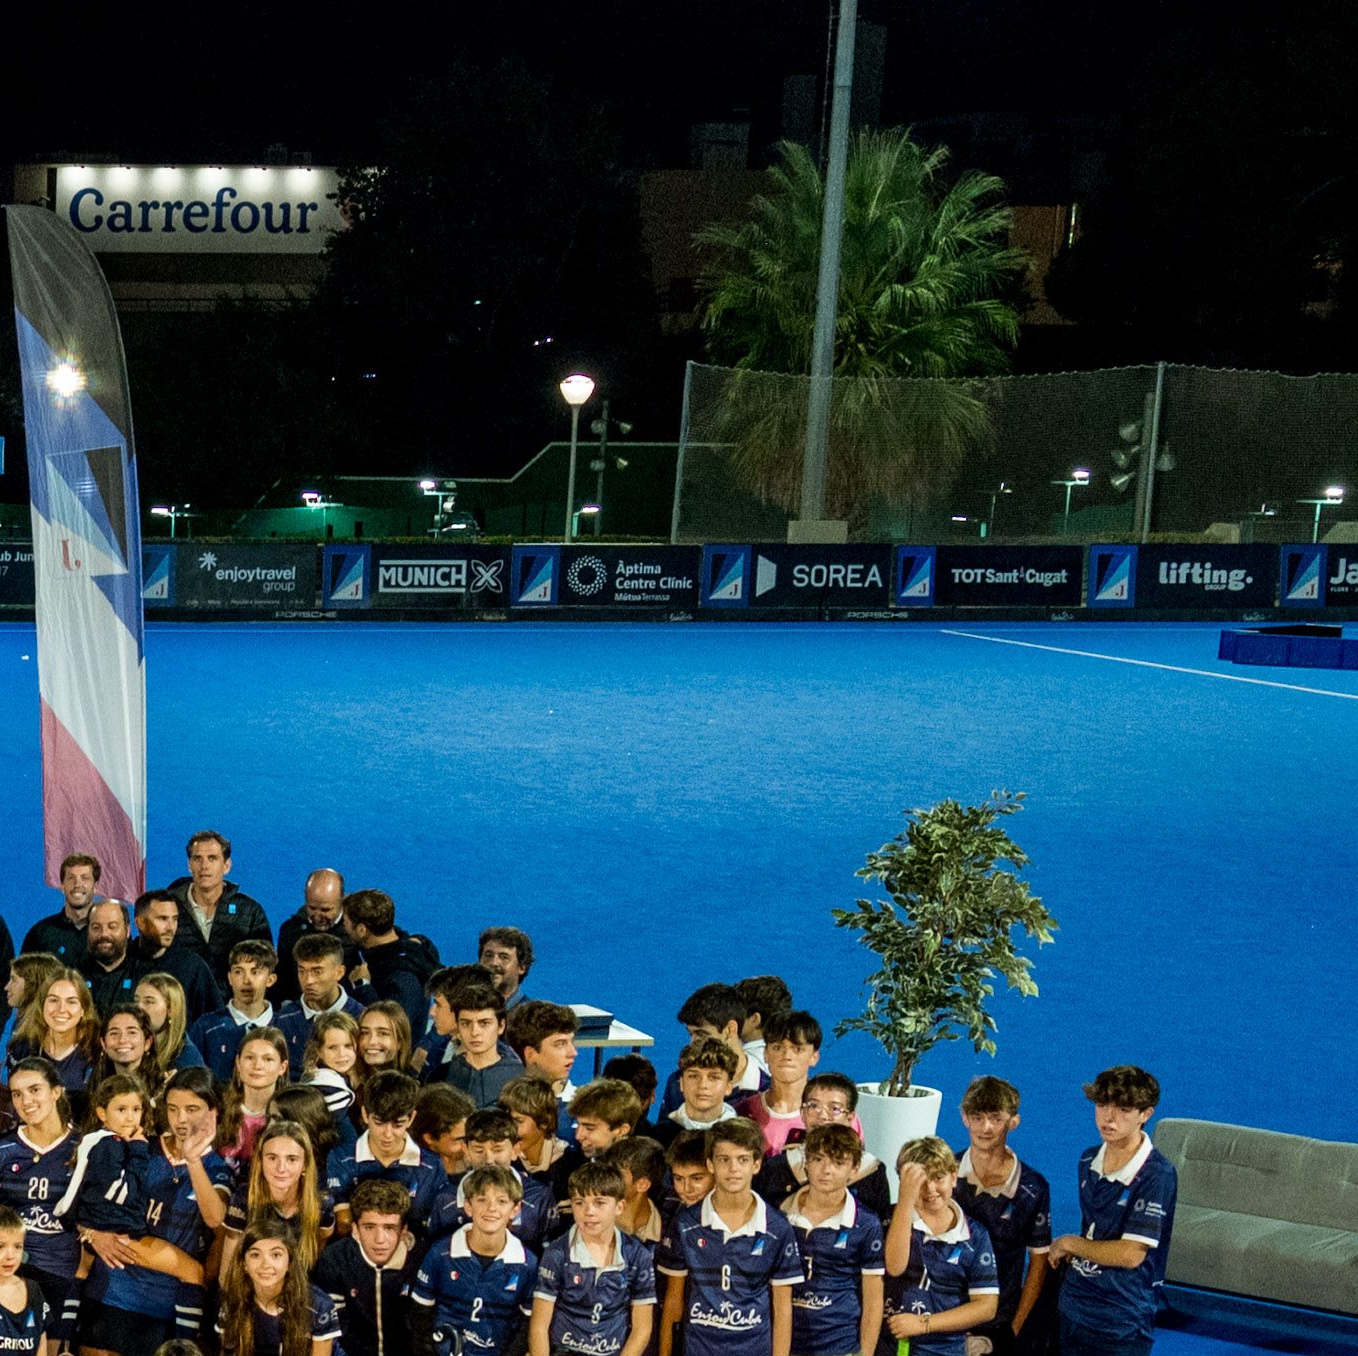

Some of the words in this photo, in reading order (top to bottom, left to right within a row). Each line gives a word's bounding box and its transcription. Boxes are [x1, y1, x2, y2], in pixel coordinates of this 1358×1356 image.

[69, 187, 318, 234] Carrefour
[14, 550, 35, 562] Jun
[215, 566, 297, 582] enjoytravel
[380, 566, 466, 587] MUNICH
[615, 577, 657, 589] Centre
[792, 564, 883, 588] SOREA
[951, 568, 982, 583] TOT
[985, 568, 1020, 583] Sant
[1025, 568, 1068, 587] Cugat
[1158, 561, 1253, 591] lifting.
[262, 579, 296, 593] group
[276, 611, 338, 619] PORSCHE
[27, 1177, 49, 1200] 28
[147, 1199, 163, 1226] 14
[721, 1264, 731, 1290] 6
[471, 1297, 483, 1322] 2
[691, 1302, 725, 1322] Enjoy
[729, 1309, 762, 1325] Cuba
[561, 1332, 595, 1352] Enjoy
[596, 1334, 621, 1350] Cuba
